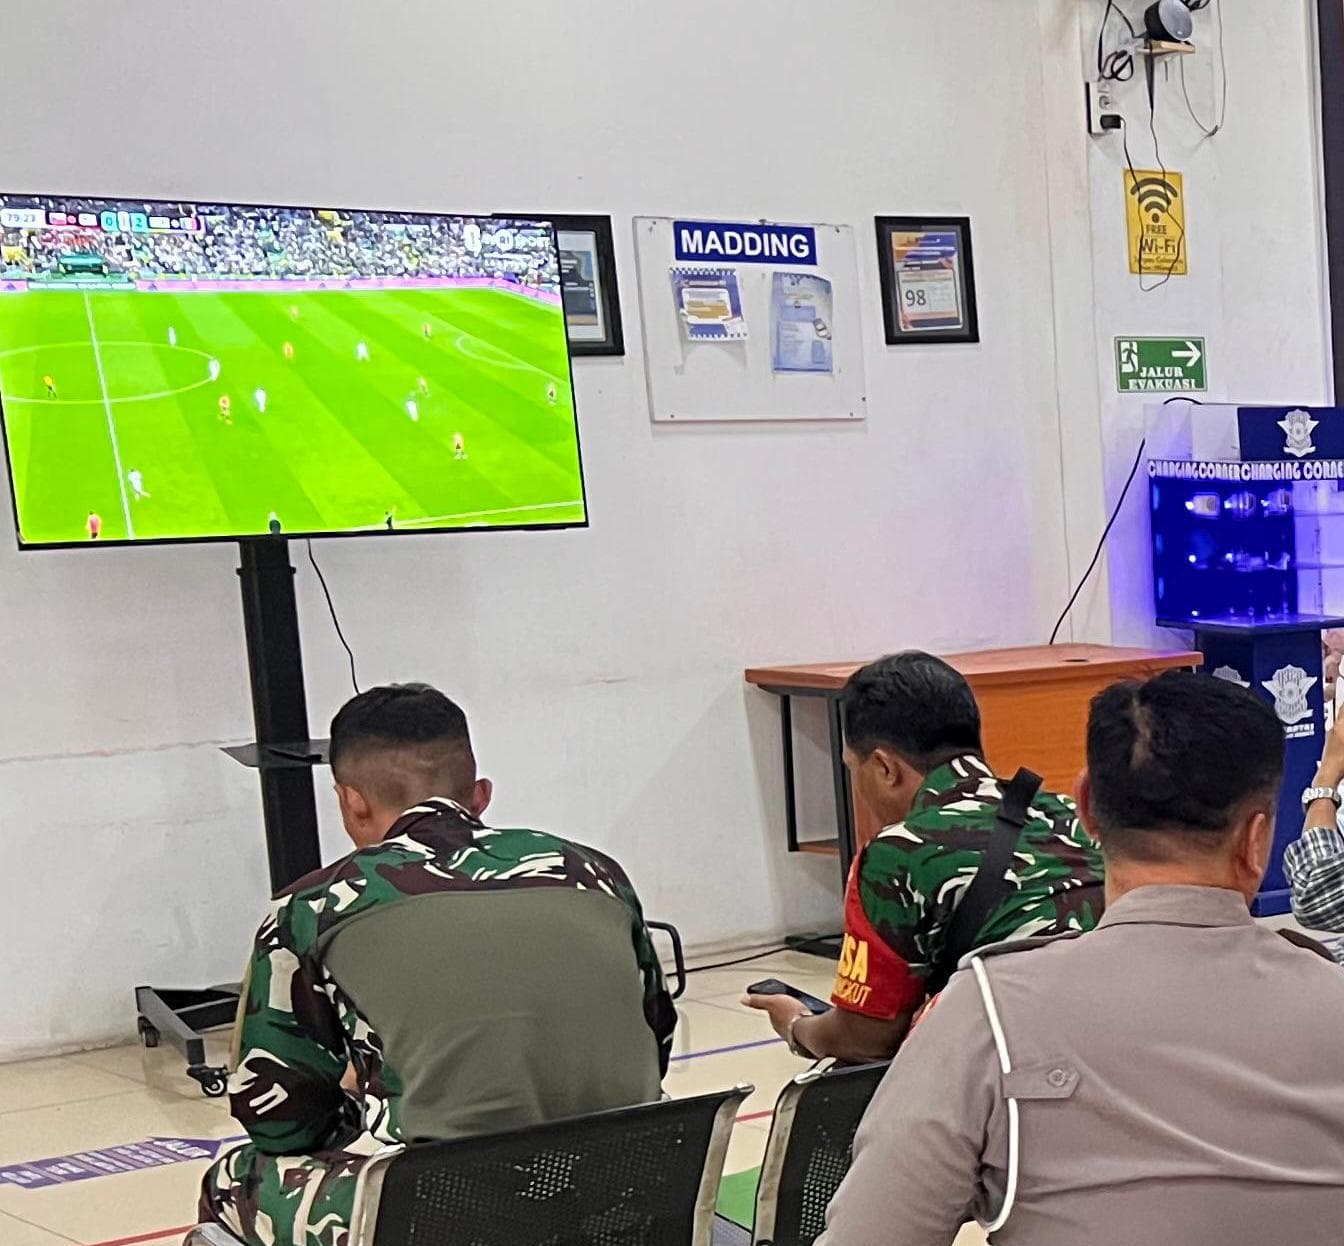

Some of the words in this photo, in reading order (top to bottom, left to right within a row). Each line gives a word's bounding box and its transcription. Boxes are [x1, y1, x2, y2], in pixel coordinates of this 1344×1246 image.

[1145, 224, 1168, 235] FREE
[680, 228, 810, 258] MADDING
[1142, 238, 1176, 254] Wi-Fi
[905, 289, 927, 307] 98
[1139, 366, 1184, 378] JALUR
[1127, 379, 1197, 391] EVAKUASI
[1200, 461, 1240, 480] CORNER
[1241, 461, 1301, 481] CHARGING
